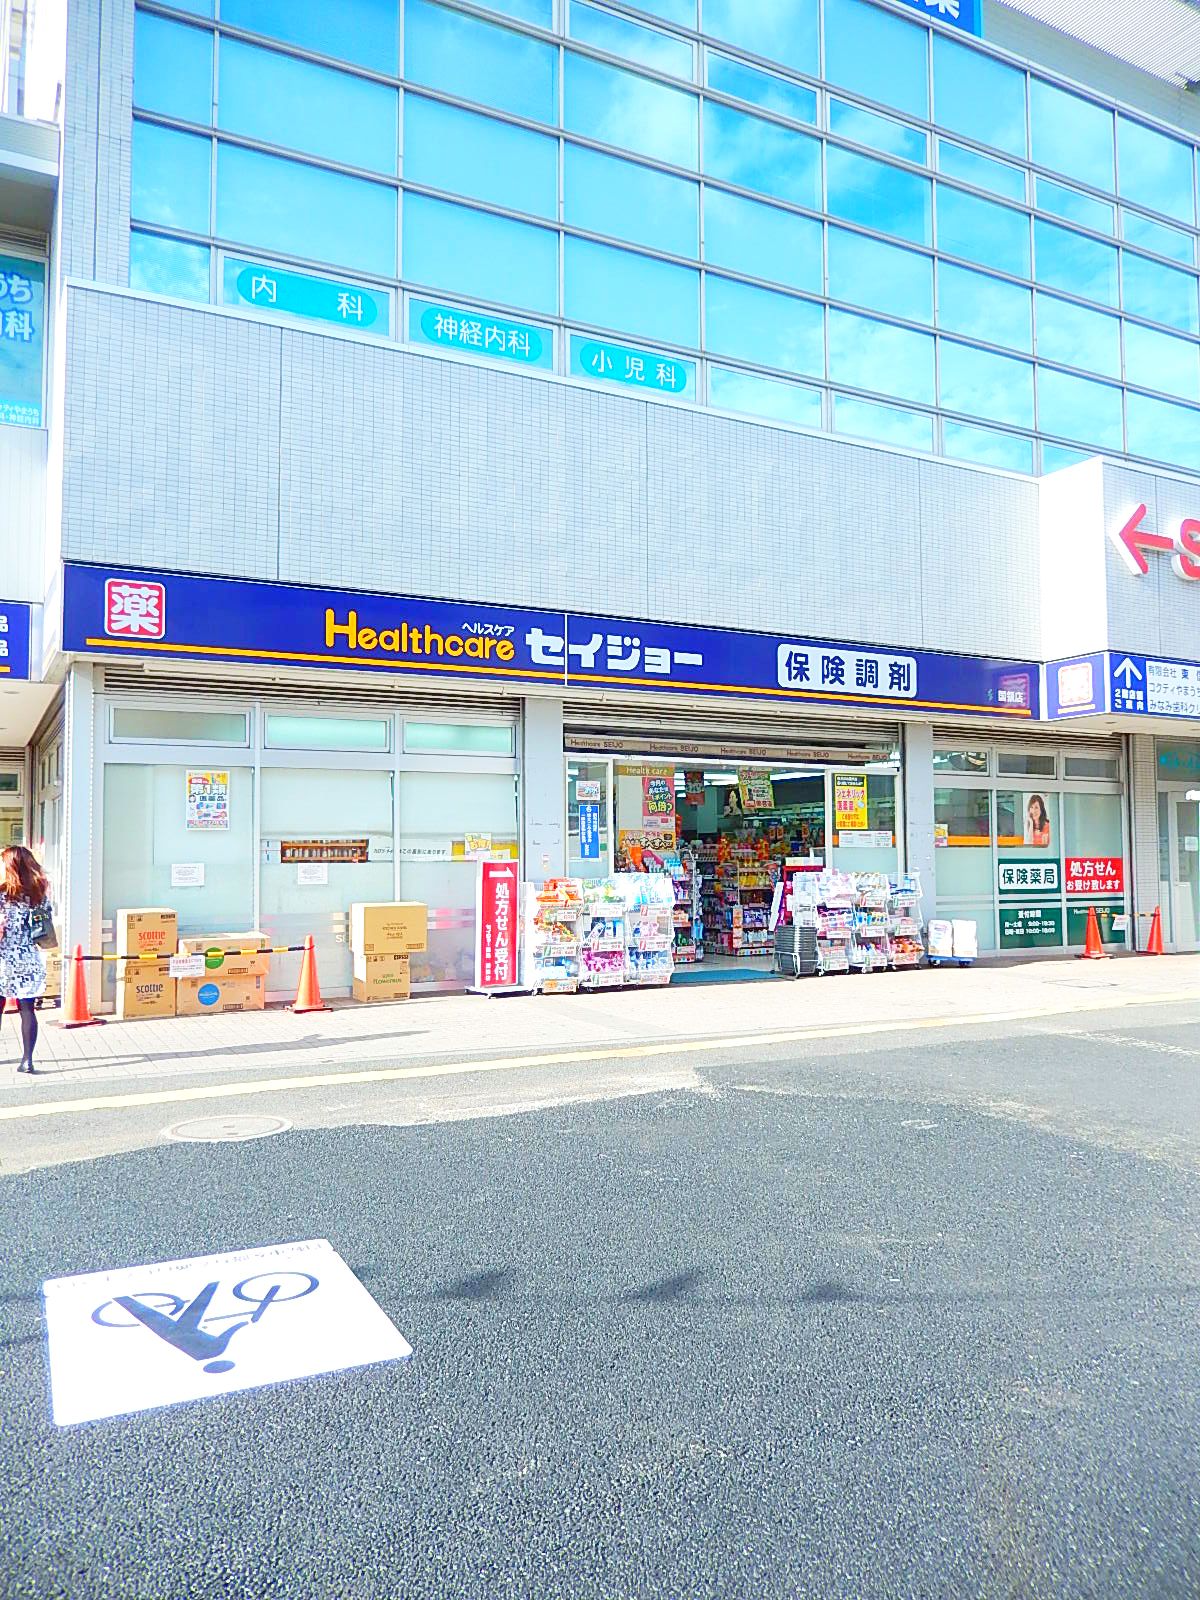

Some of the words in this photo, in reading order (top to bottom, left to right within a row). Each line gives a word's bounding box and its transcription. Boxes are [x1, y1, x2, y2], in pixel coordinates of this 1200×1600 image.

[251, 273, 364, 321] 内科
[433, 312, 531, 358] 神経内科
[591, 349, 677, 389] 小児科
[110, 584, 160, 634] 薬
[462, 622, 515, 637] ヘルスケア
[325, 608, 515, 661] Healthcare
[525, 627, 703, 674] セイジョー
[784, 650, 911, 692] 保険調剤
[1002, 868, 1055, 885] 保険薬局
[1066, 879, 1121, 892] お受け致します
[1070, 860, 1117, 877] 処方せん
[494, 882, 510, 981] 処方せん受付
